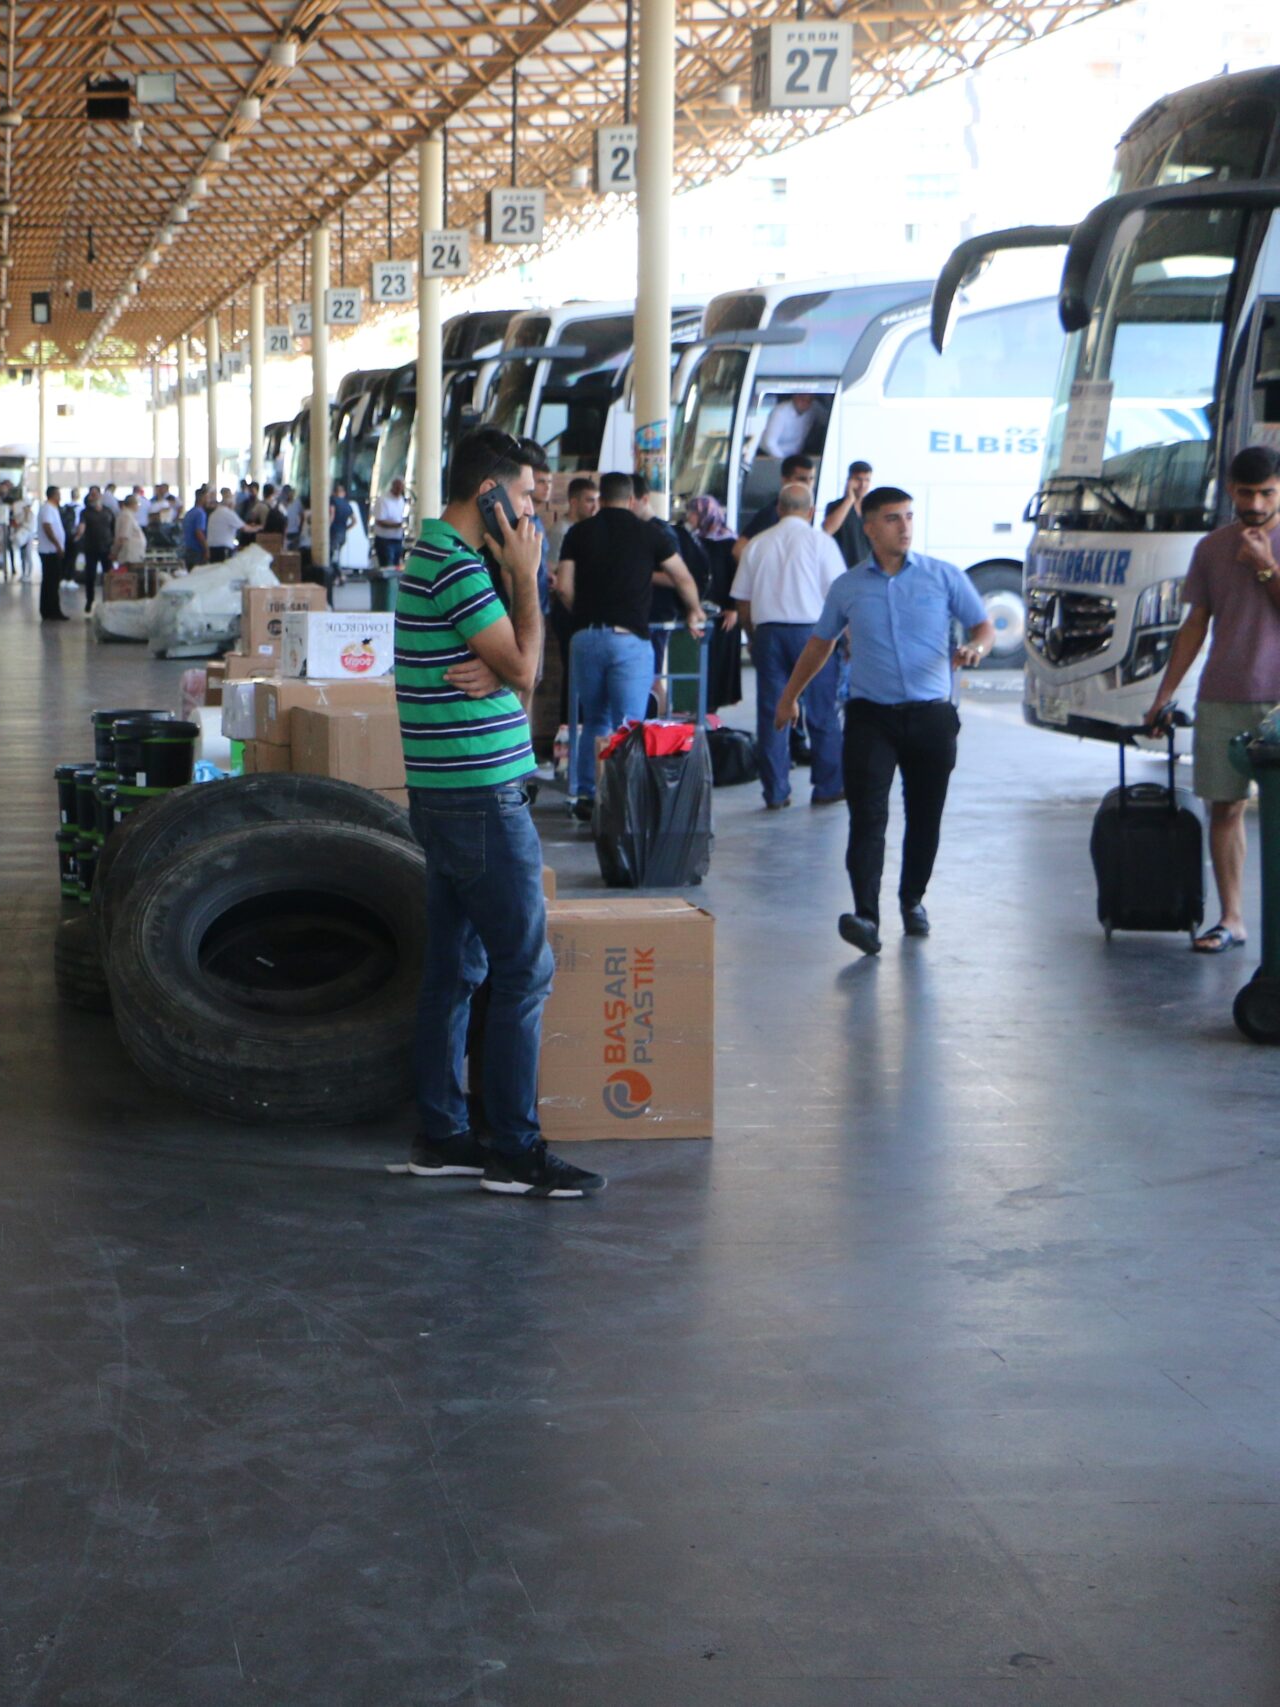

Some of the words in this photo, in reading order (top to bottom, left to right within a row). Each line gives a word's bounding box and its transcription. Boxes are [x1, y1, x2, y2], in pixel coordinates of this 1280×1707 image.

[787, 31, 839, 41] PERON
[785, 47, 838, 93] 27
[611, 147, 637, 181] 2
[501, 205, 535, 233] 25
[431, 244, 461, 269] 24
[381, 274, 406, 296] 23
[332, 300, 355, 319] 22
[298, 313, 311, 330] 2
[271, 335, 288, 352] 20
[326, 621, 391, 633] TOMURCUK
[604, 947, 633, 1065] BAŞARI
[629, 946, 655, 1065] PLASTİK
